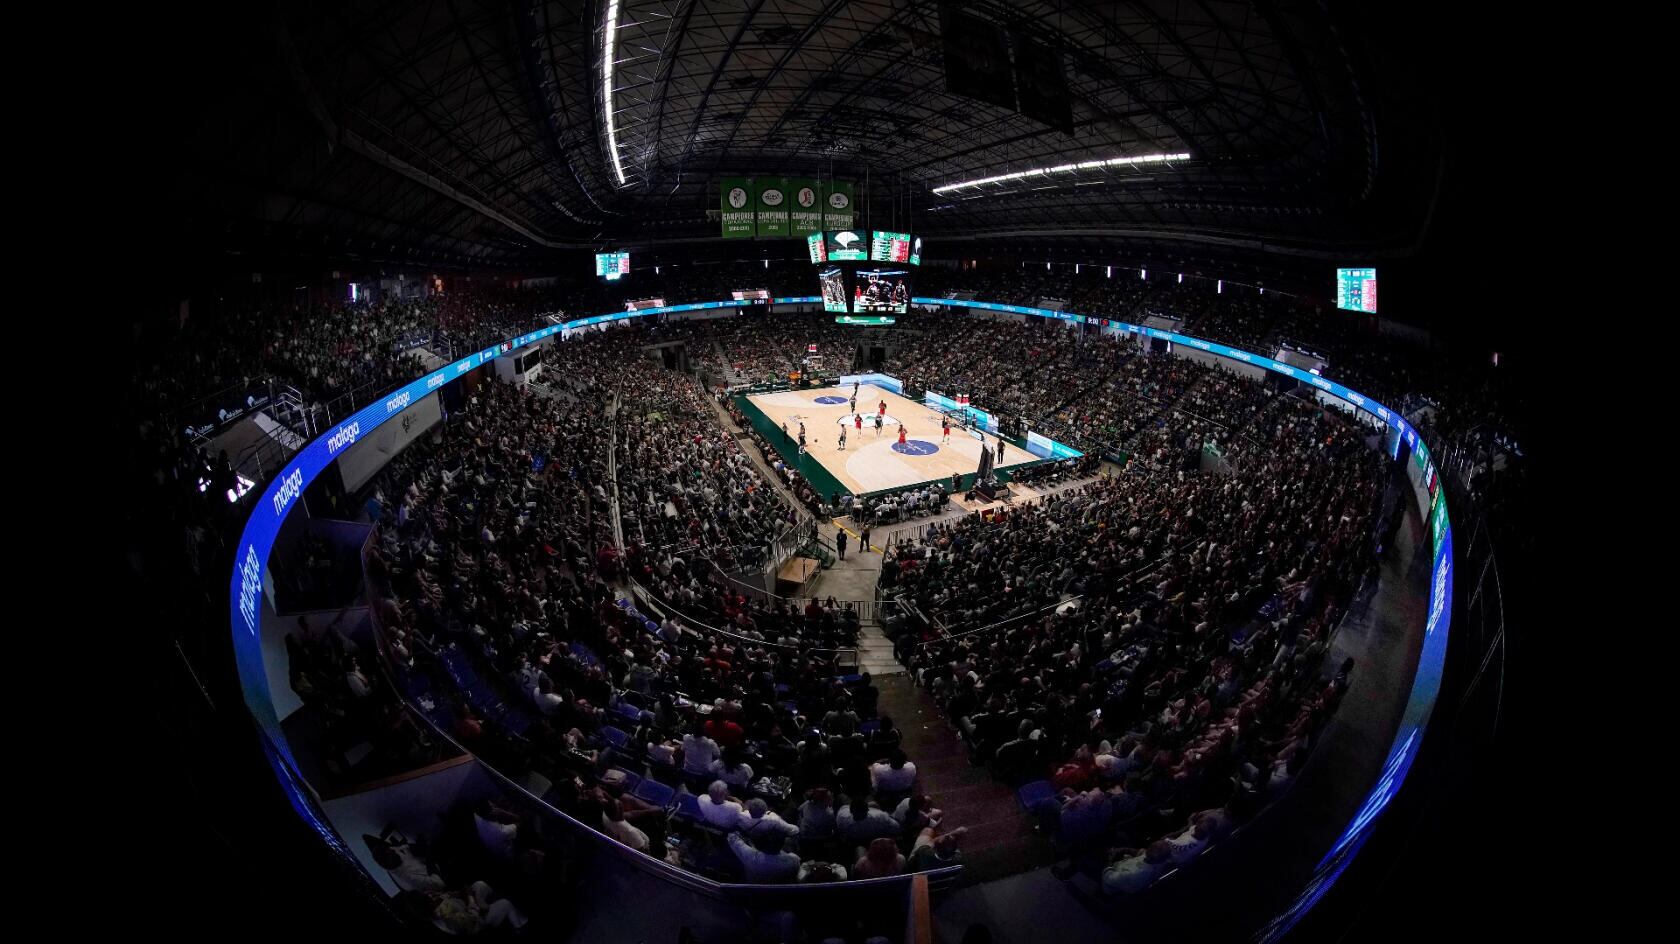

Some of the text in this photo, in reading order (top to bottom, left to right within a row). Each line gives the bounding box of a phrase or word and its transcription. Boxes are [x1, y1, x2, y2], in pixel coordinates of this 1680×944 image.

[328, 421, 360, 454] malaga
[273, 468, 302, 516] malaga
[239, 544, 261, 636] malaga
